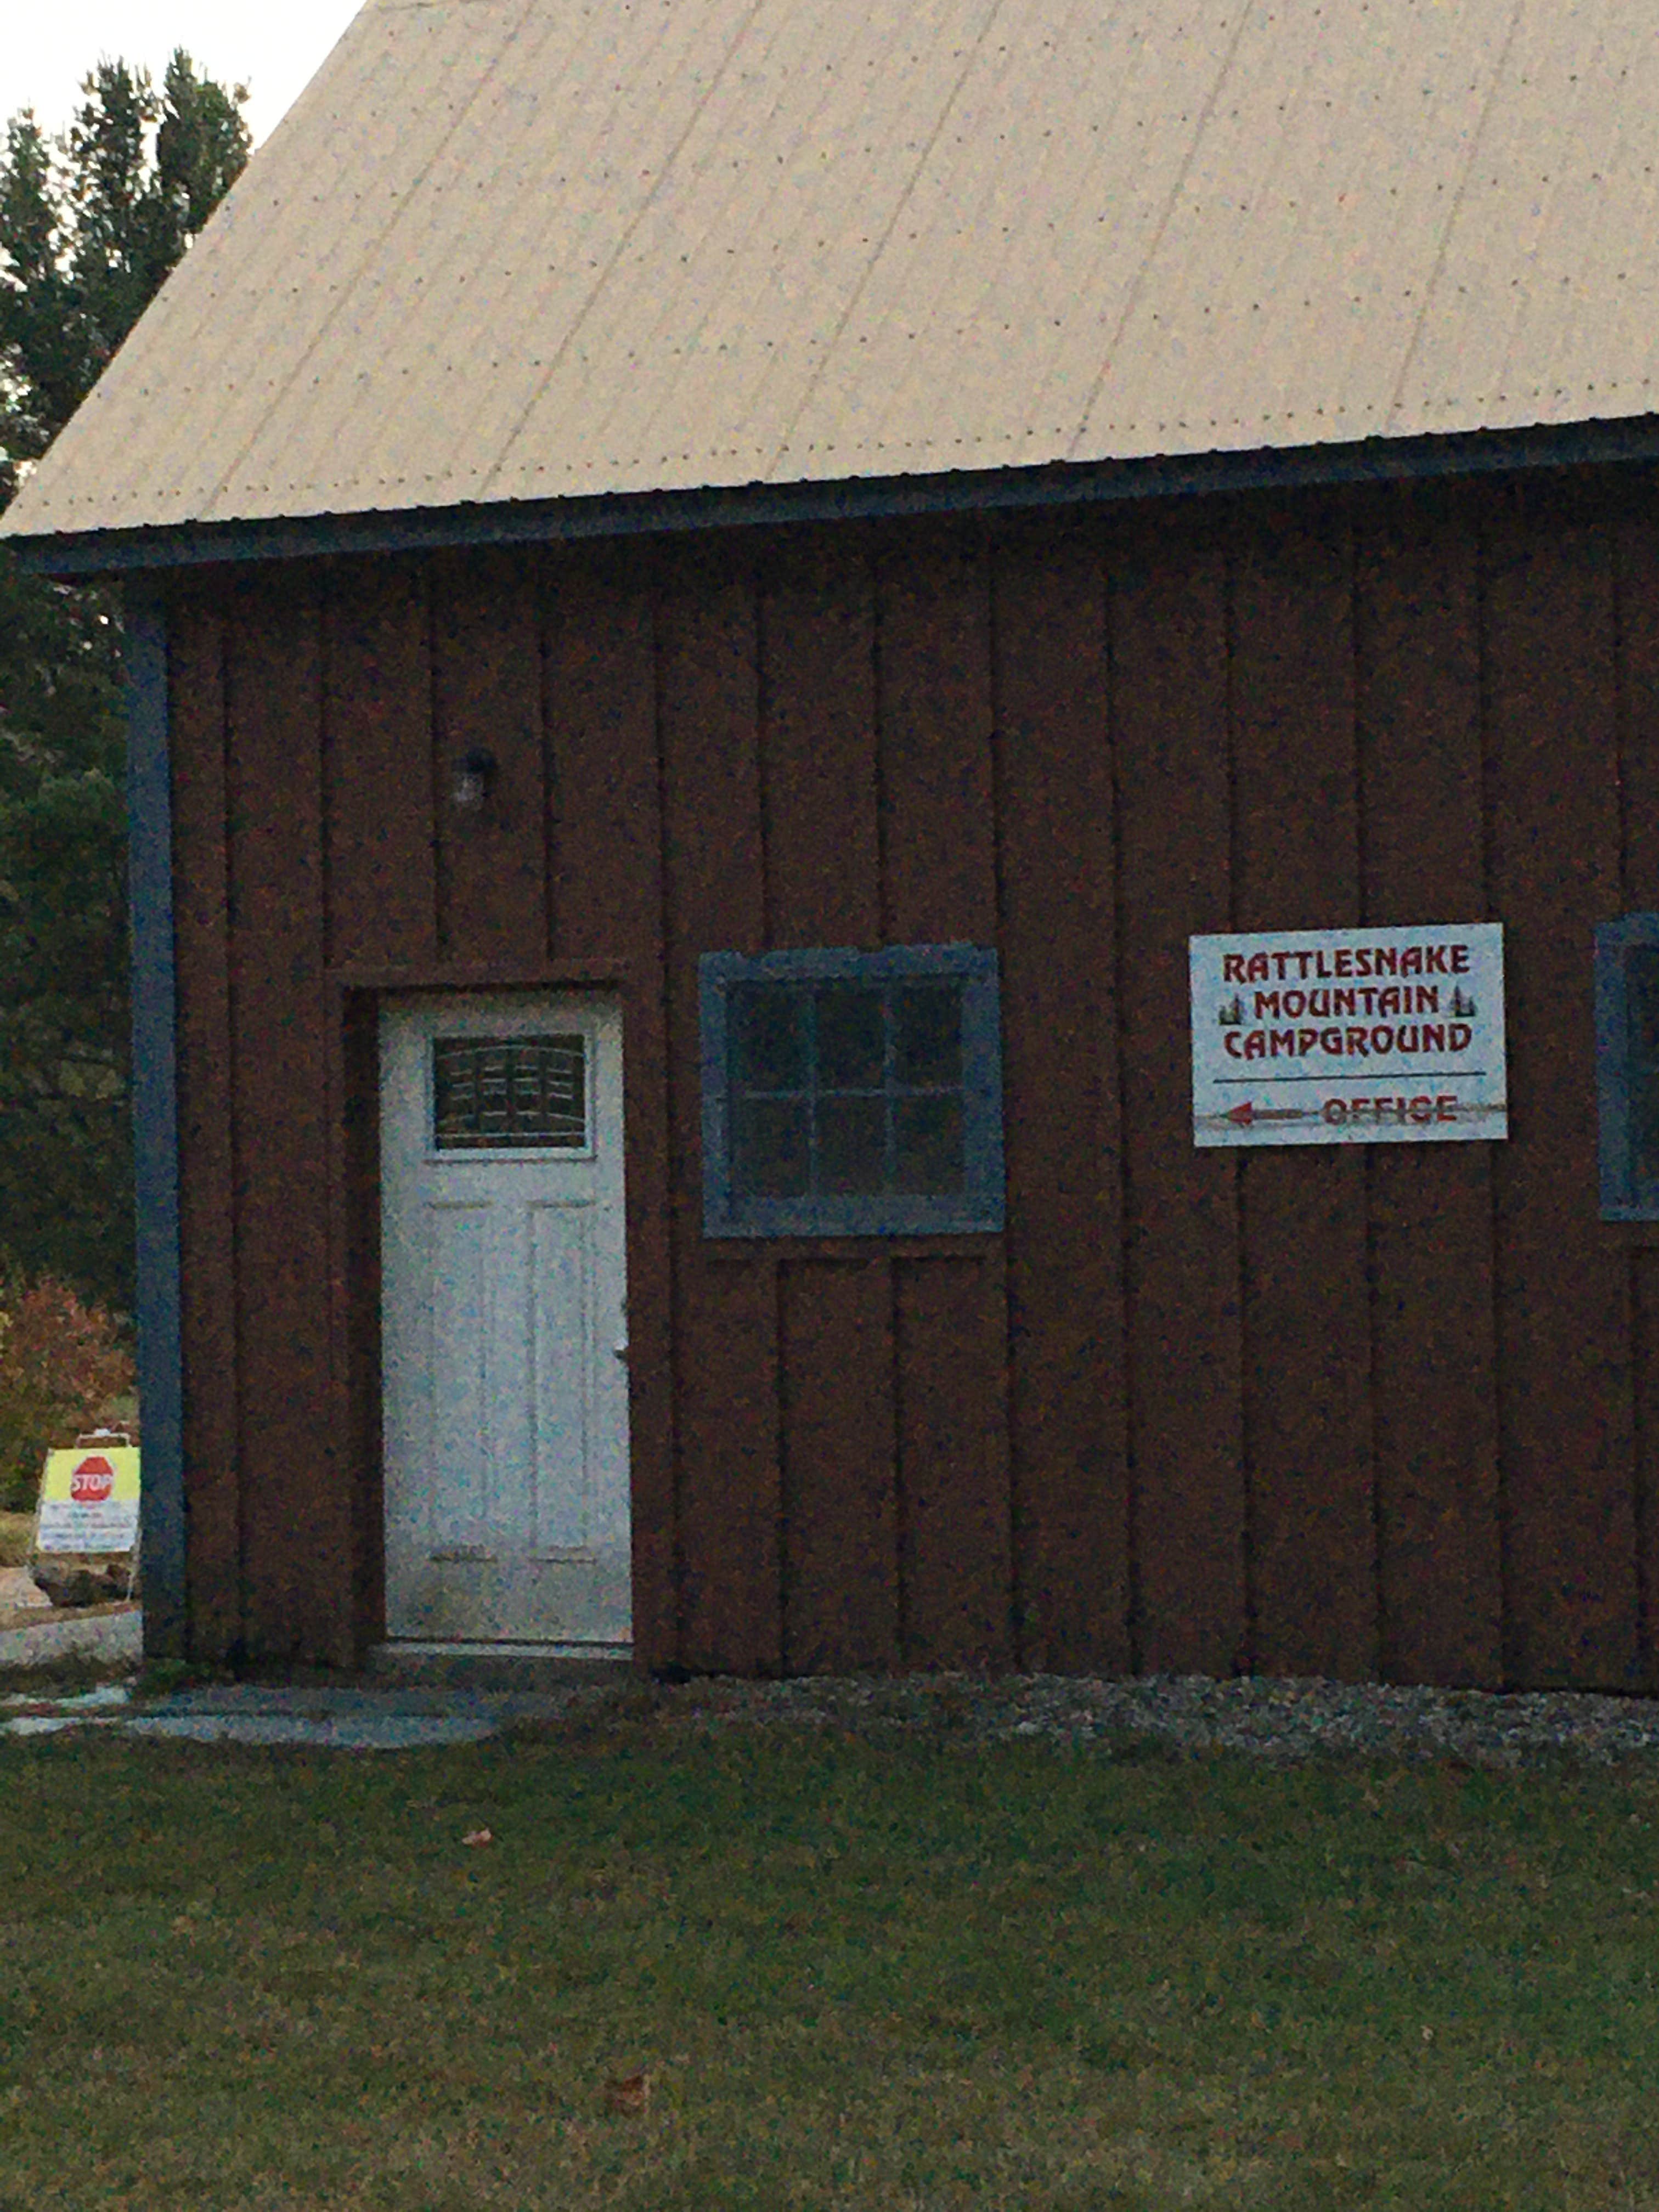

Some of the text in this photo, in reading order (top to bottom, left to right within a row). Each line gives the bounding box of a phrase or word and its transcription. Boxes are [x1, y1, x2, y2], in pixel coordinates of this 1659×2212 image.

[1223, 945, 1470, 984] RATTLESNAKE
[1254, 985, 1439, 1019] MOUNTAIN
[1224, 1024, 1472, 1060] CAMPGROUND
[1323, 1095, 1458, 1125] OFFICE
[71, 1475, 114, 1491] STOP
